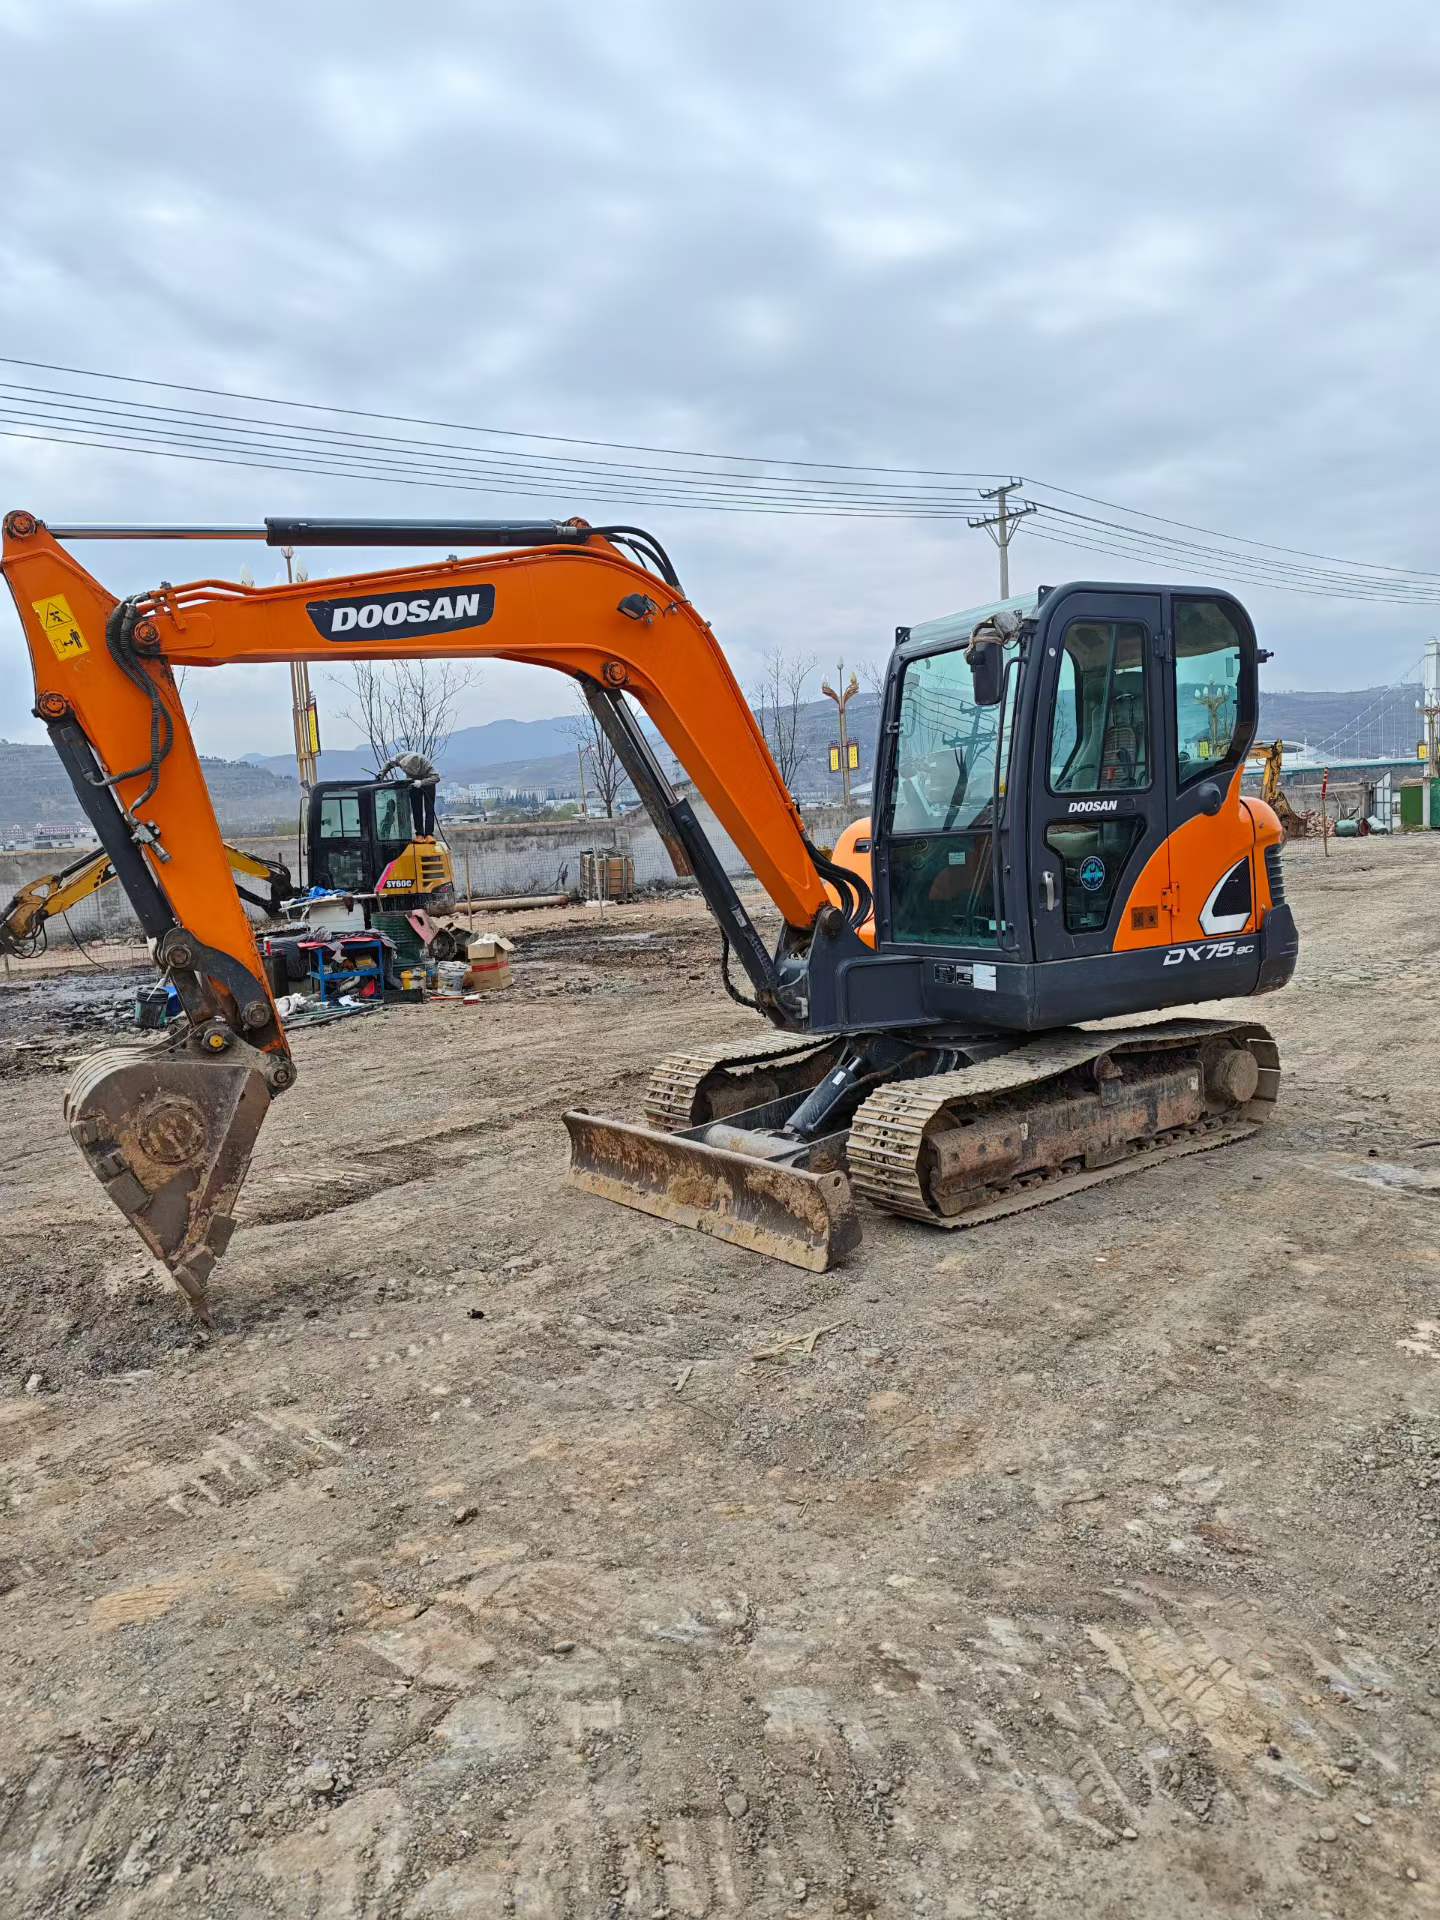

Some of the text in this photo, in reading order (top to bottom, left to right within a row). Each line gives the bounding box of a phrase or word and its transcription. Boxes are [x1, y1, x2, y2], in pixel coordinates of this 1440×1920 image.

[331, 594, 480, 632] DOOSAN
[1068, 800, 1117, 812] DOOSAN
[386, 880, 411, 888] SY60C
